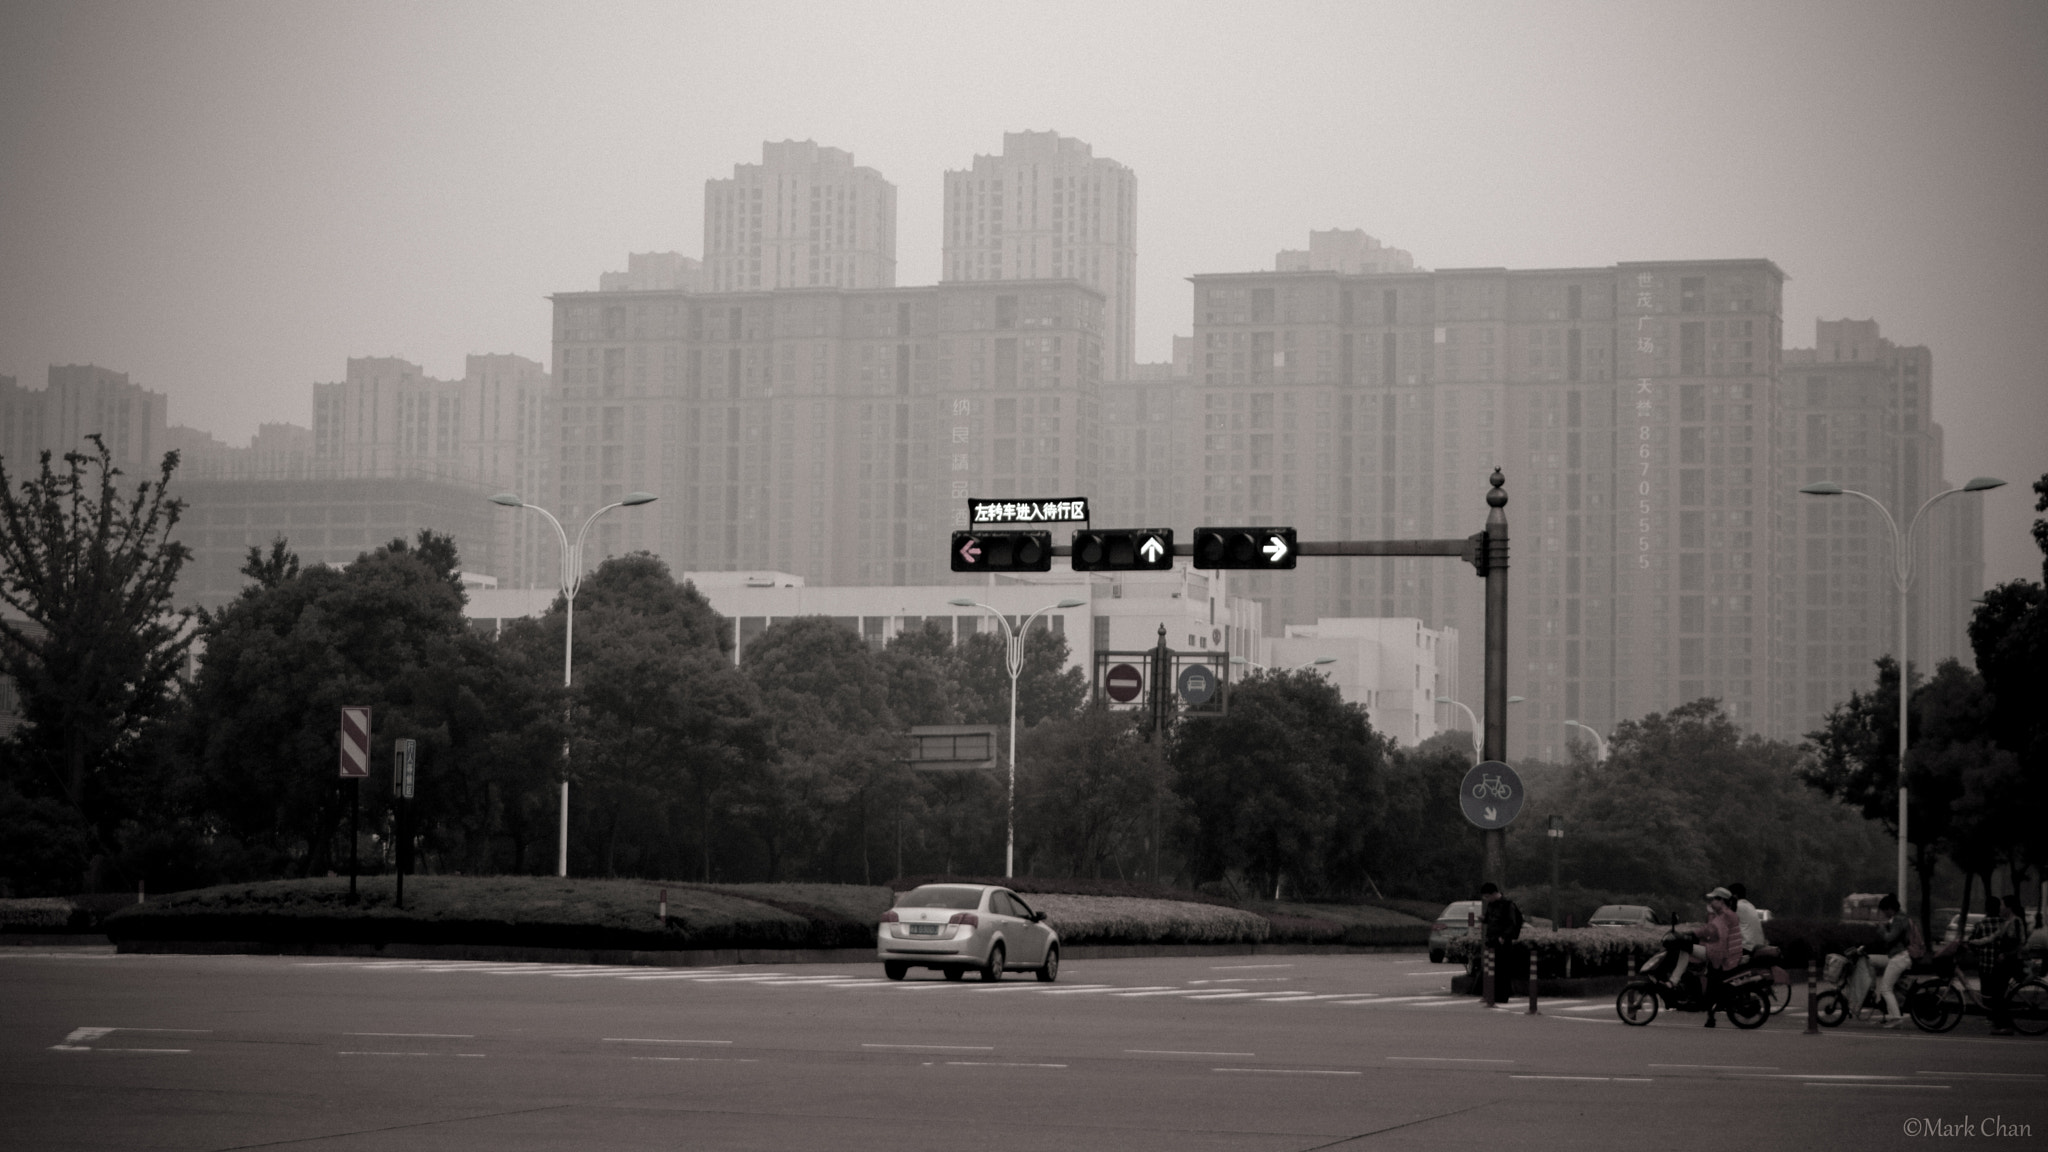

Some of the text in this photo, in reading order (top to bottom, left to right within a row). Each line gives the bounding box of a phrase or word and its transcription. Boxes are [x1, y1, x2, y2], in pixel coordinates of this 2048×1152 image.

[1636, 272, 1653, 353] 世茂广场
[974, 501, 1085, 521] 左转车进入待行区
[1639, 426, 1650, 570] 86705555
